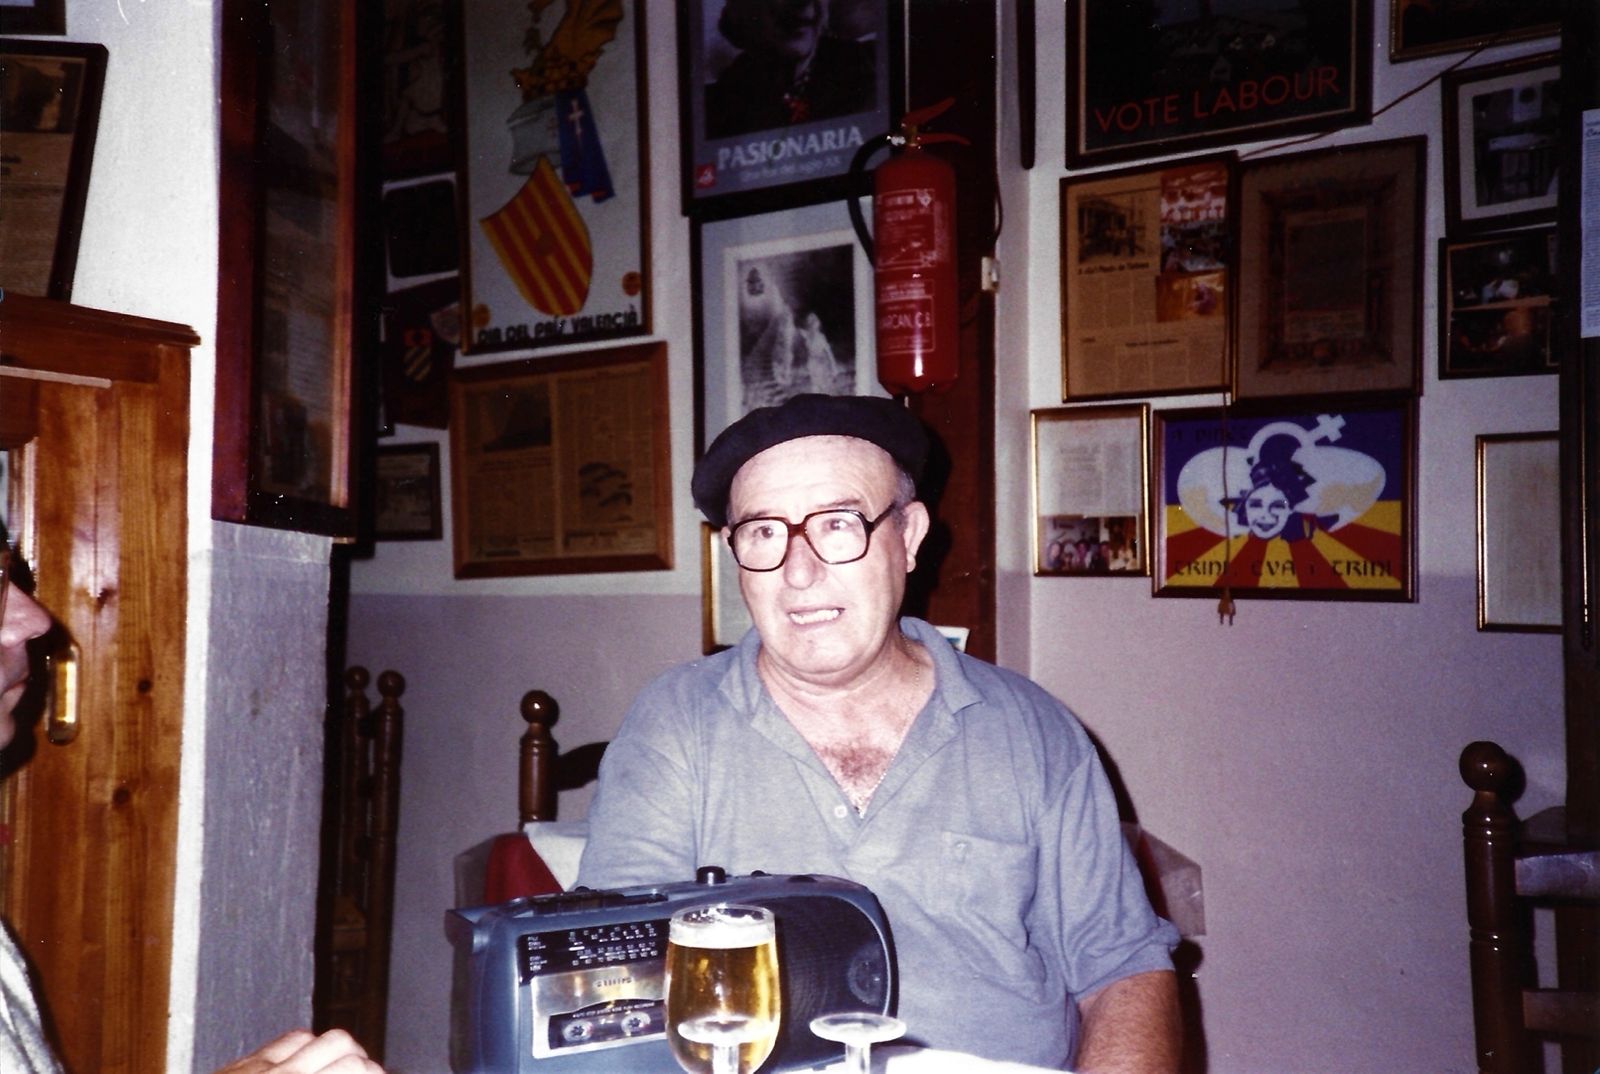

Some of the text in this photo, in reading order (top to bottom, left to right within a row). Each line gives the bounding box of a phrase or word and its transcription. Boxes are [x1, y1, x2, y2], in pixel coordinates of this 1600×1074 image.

[1093, 65, 1341, 133] VOTE LABOUR
[716, 125, 865, 171] PASIONARIA
[1331, 558, 1392, 577] TRINI
